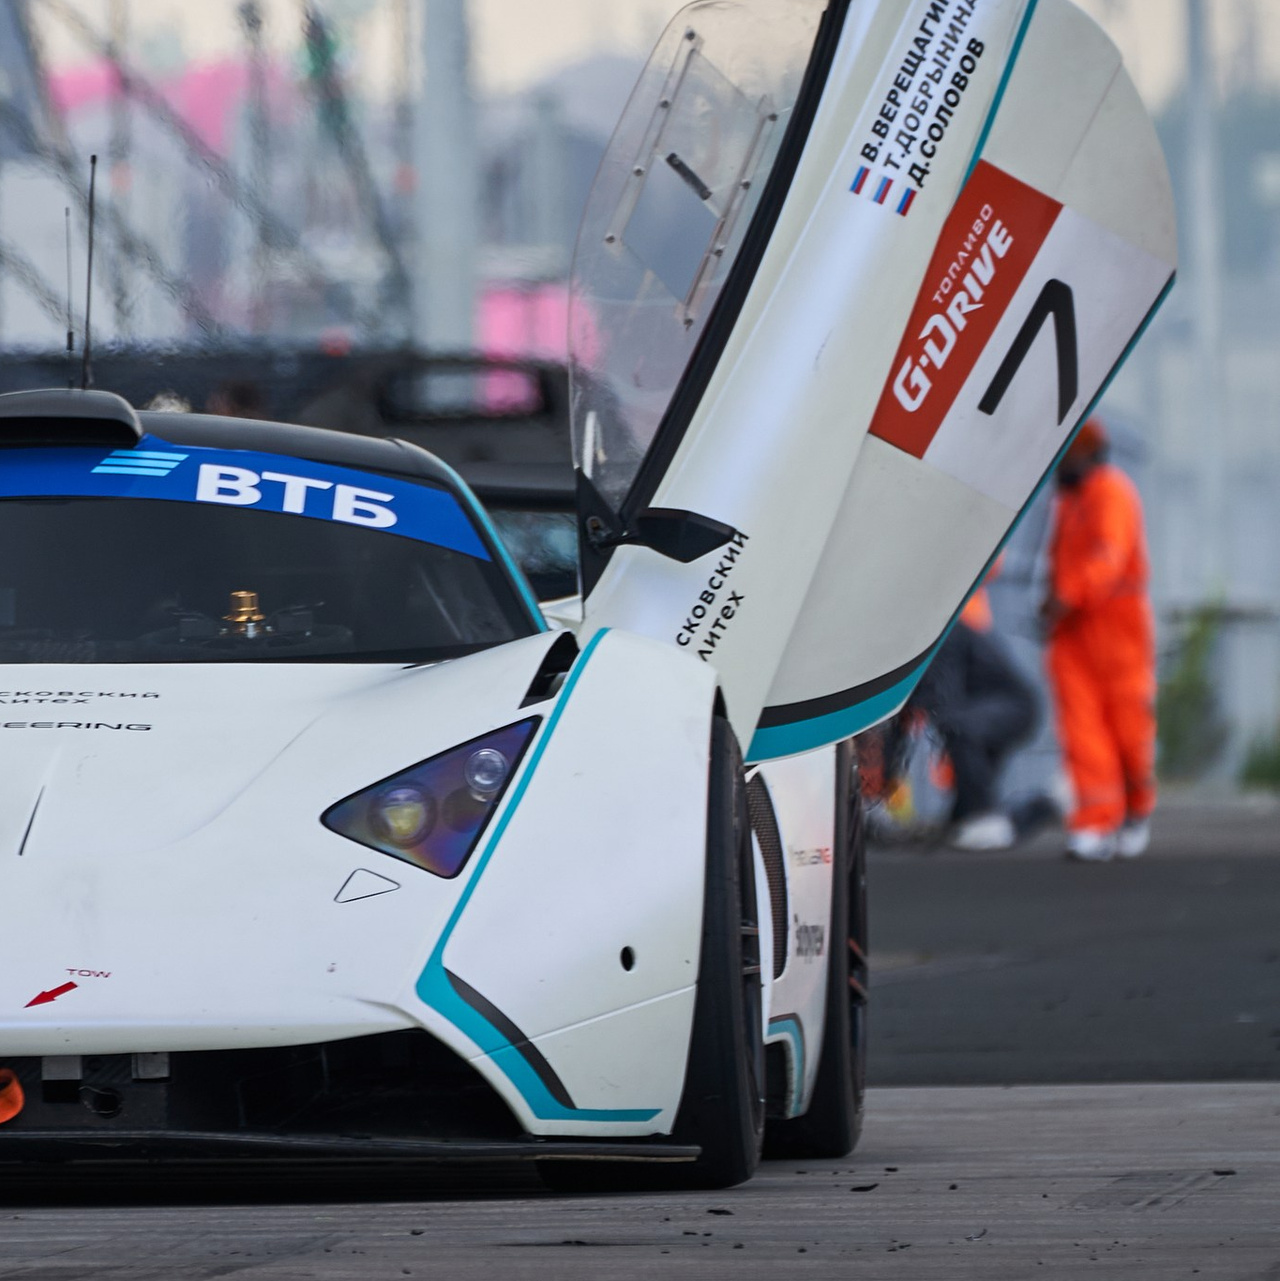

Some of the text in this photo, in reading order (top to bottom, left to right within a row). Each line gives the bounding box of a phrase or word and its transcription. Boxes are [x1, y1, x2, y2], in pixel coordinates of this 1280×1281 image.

[907, 37, 985, 188] Д.СОЛОВОВ
[932, 204, 994, 303] ТОПЛИВО
[977, 278, 1079, 426] 7
[196, 463, 398, 528] ВТБ
[676, 530, 750, 647] СКОВСКИЙ
[65, 968, 112, 979] TOW
